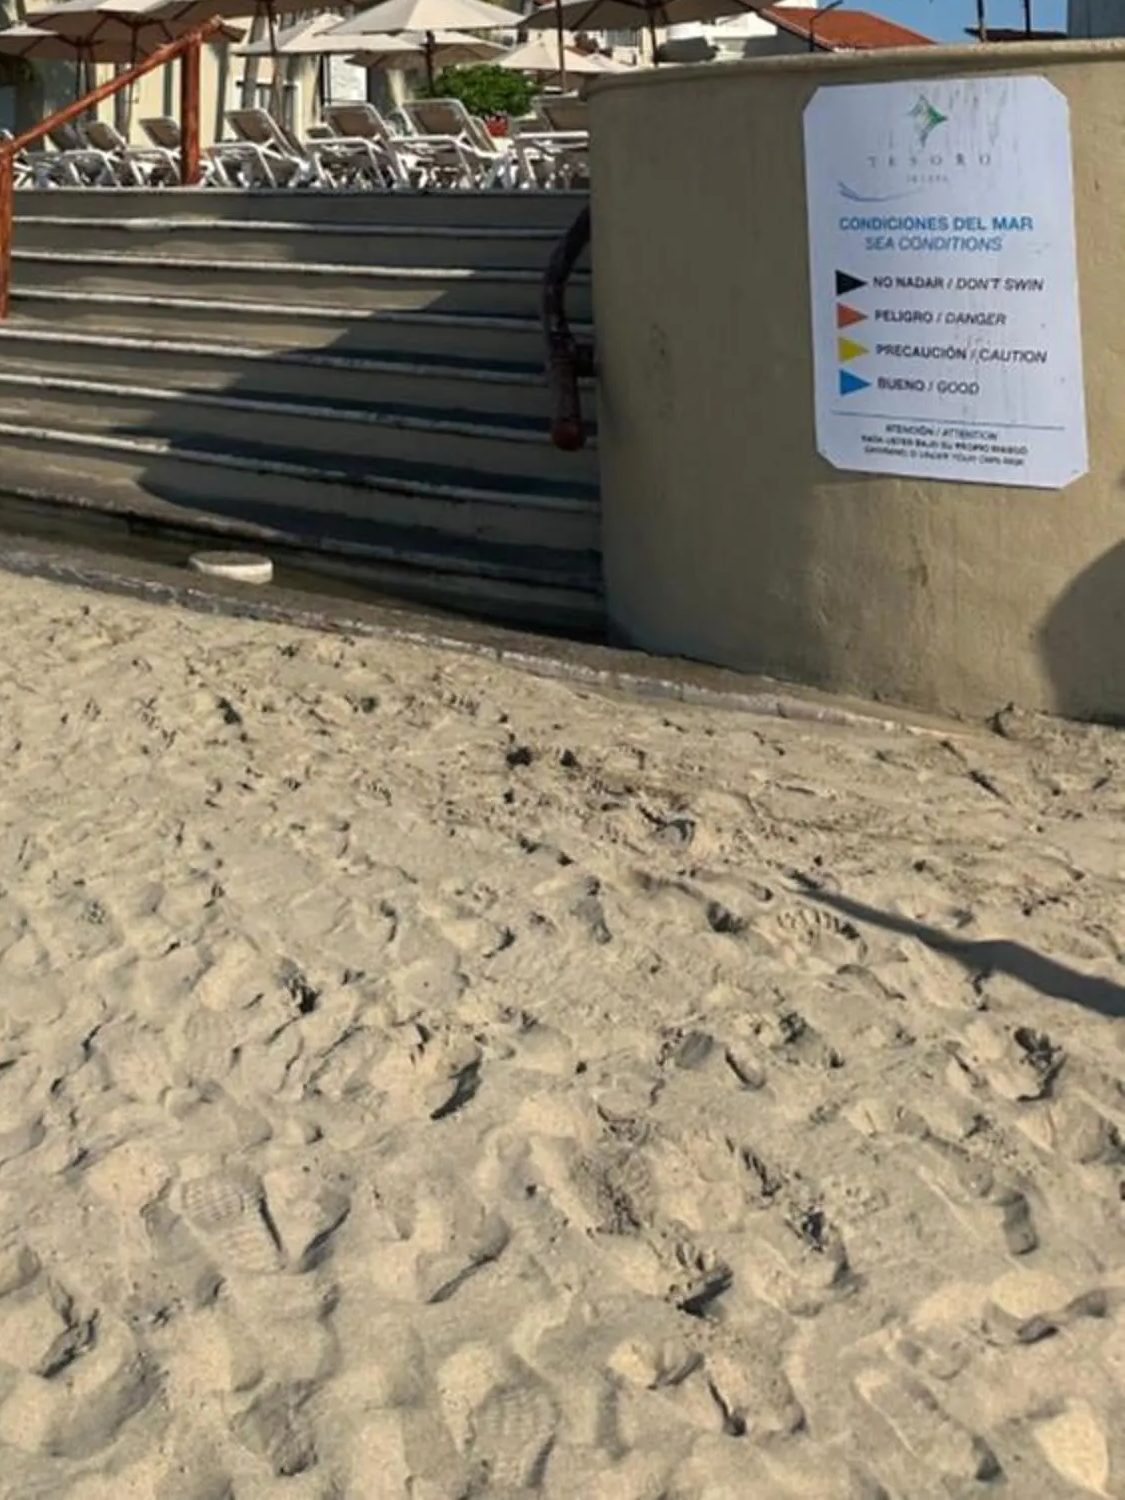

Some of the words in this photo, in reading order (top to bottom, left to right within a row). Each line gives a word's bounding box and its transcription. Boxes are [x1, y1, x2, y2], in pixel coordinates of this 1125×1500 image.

[839, 216, 949, 231] CONDICIONES
[953, 216, 986, 231] DEL
[992, 216, 1034, 231] MAR
[865, 236, 895, 251] SEA
[898, 236, 1003, 252] CONDITIONS
[873, 276, 893, 289] NO
[896, 276, 944, 290] NADAR
[955, 277, 1001, 291] DON'T
[875, 309, 934, 324] PELIGRO
[945, 311, 1007, 326] DANGER
[876, 343, 967, 360] PRECAUCIÓN
[979, 348, 1048, 364] CAUTION
[877, 377, 924, 391] BUENO
[937, 380, 980, 395] GOOD
